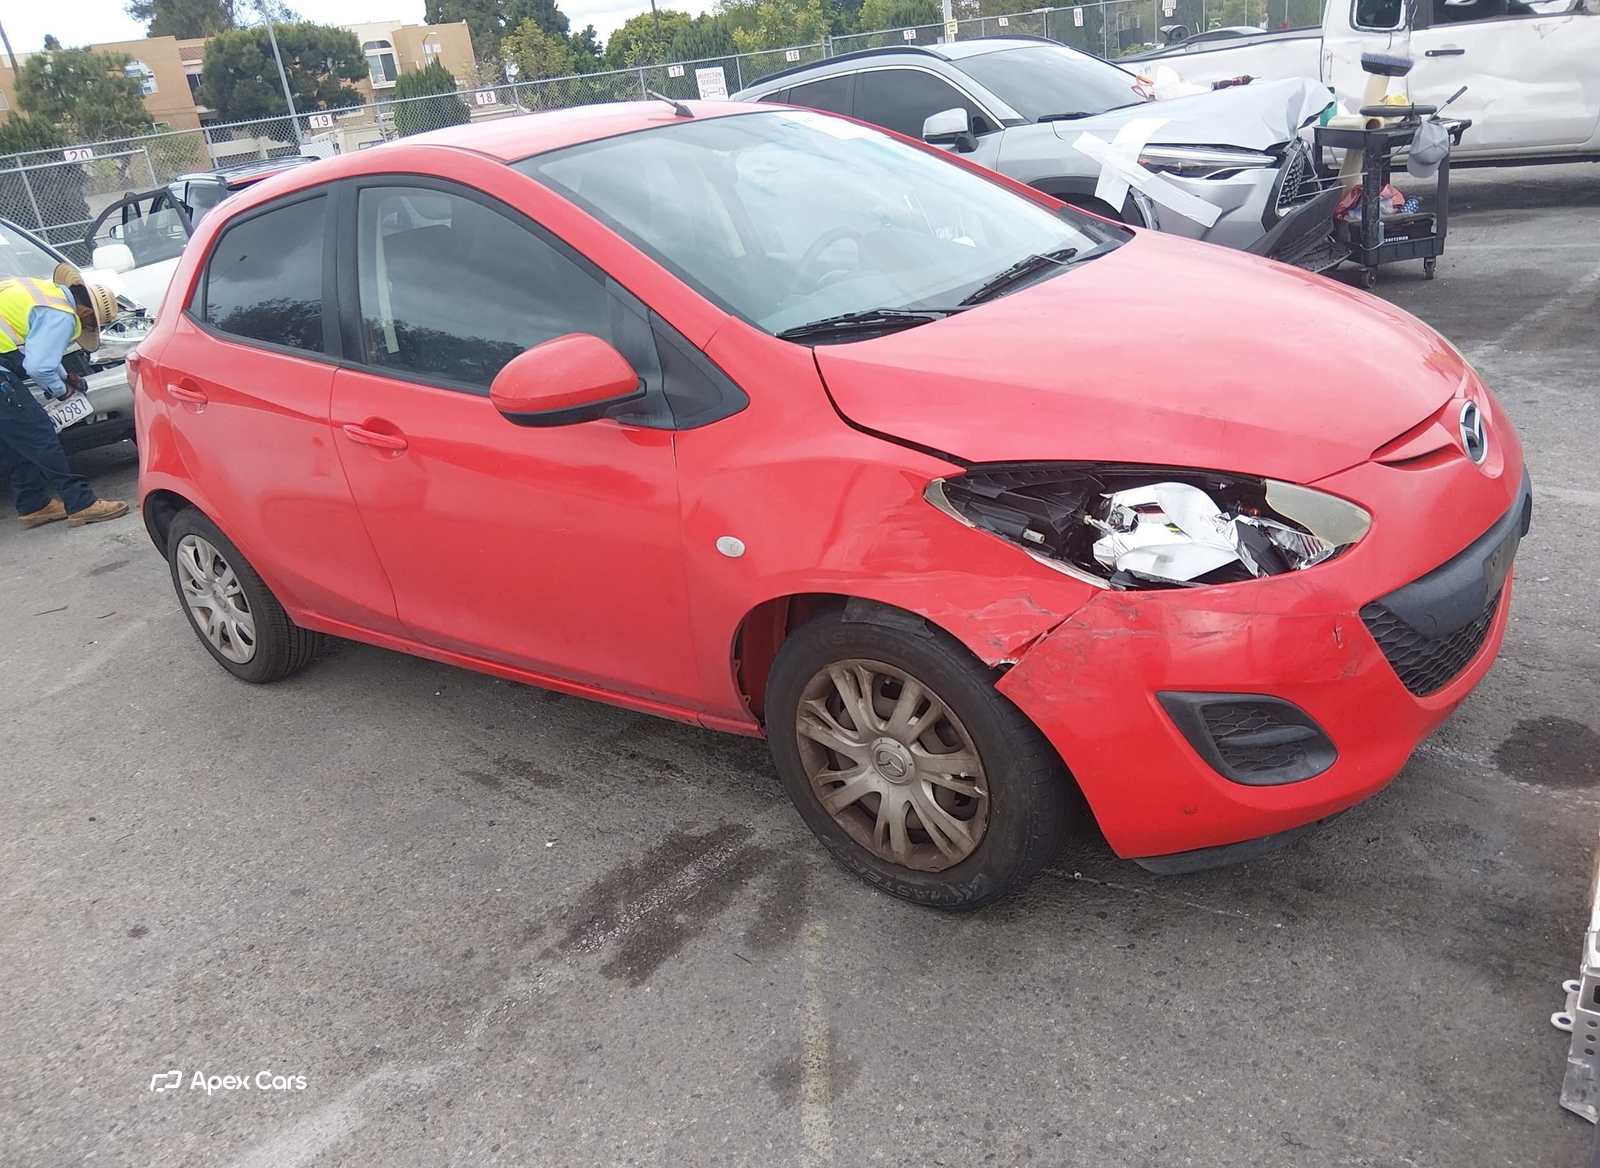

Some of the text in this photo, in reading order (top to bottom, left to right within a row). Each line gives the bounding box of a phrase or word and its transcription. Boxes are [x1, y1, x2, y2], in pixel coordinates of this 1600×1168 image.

[789, 51, 798, 60] 16
[672, 66, 682, 75] 17
[479, 93, 493, 103] 18
[314, 116, 329, 127] 19
[69, 149, 89, 160] 20
